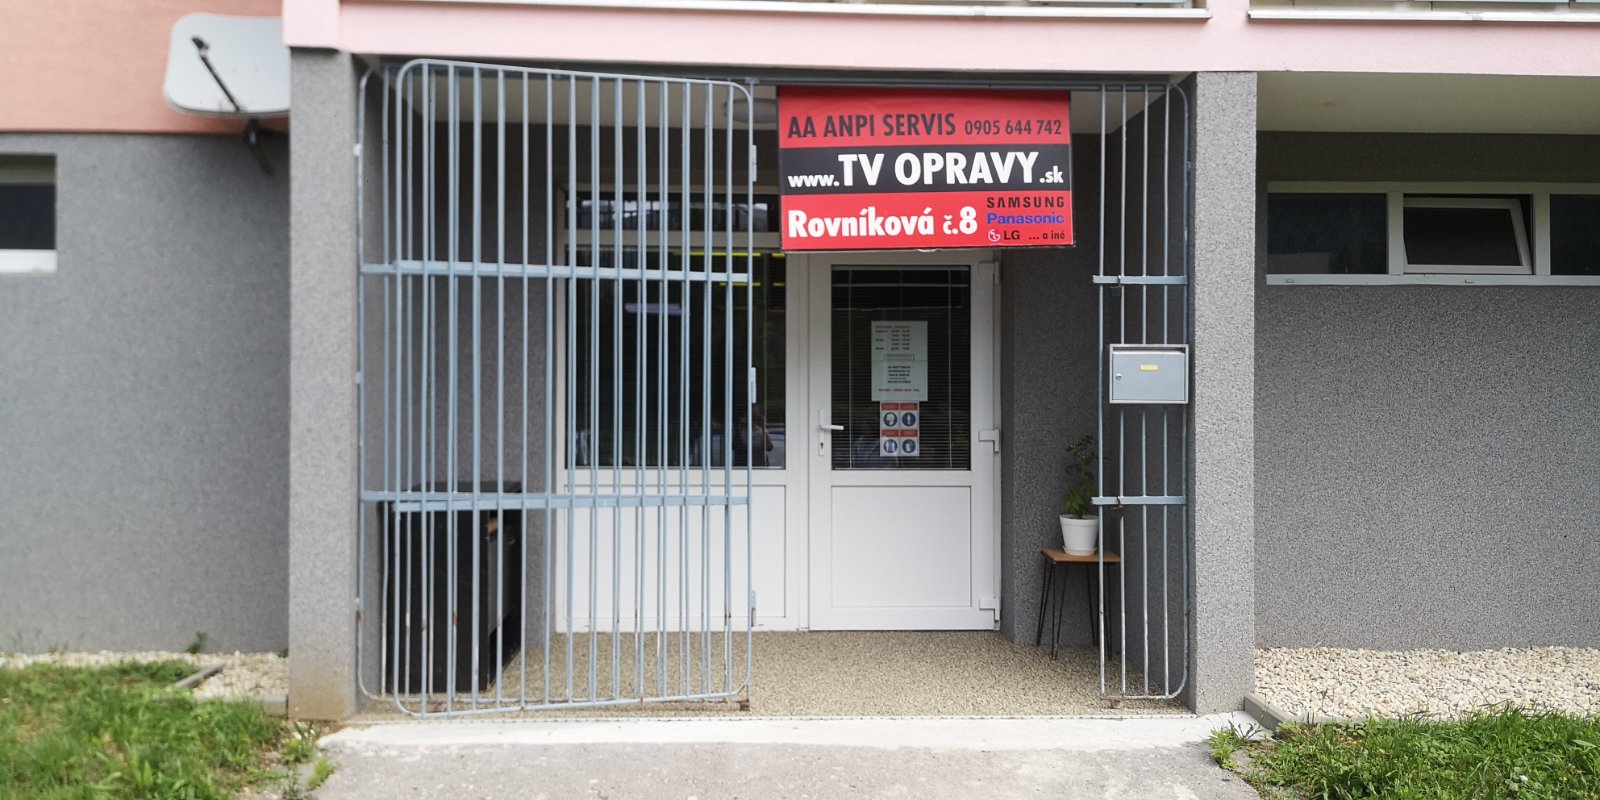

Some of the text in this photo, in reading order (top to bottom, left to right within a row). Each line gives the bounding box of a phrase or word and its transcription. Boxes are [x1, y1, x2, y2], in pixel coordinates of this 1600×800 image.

[788, 112, 1062, 138] AA ANPI SERVIS 0905 644 742
[986, 196, 1065, 208] SAMSUNG
[788, 206, 935, 238] Rovníková
[986, 212, 1065, 224] Panasonic
[1003, 230, 1020, 240] LG
[1051, 229, 1066, 240] iné
